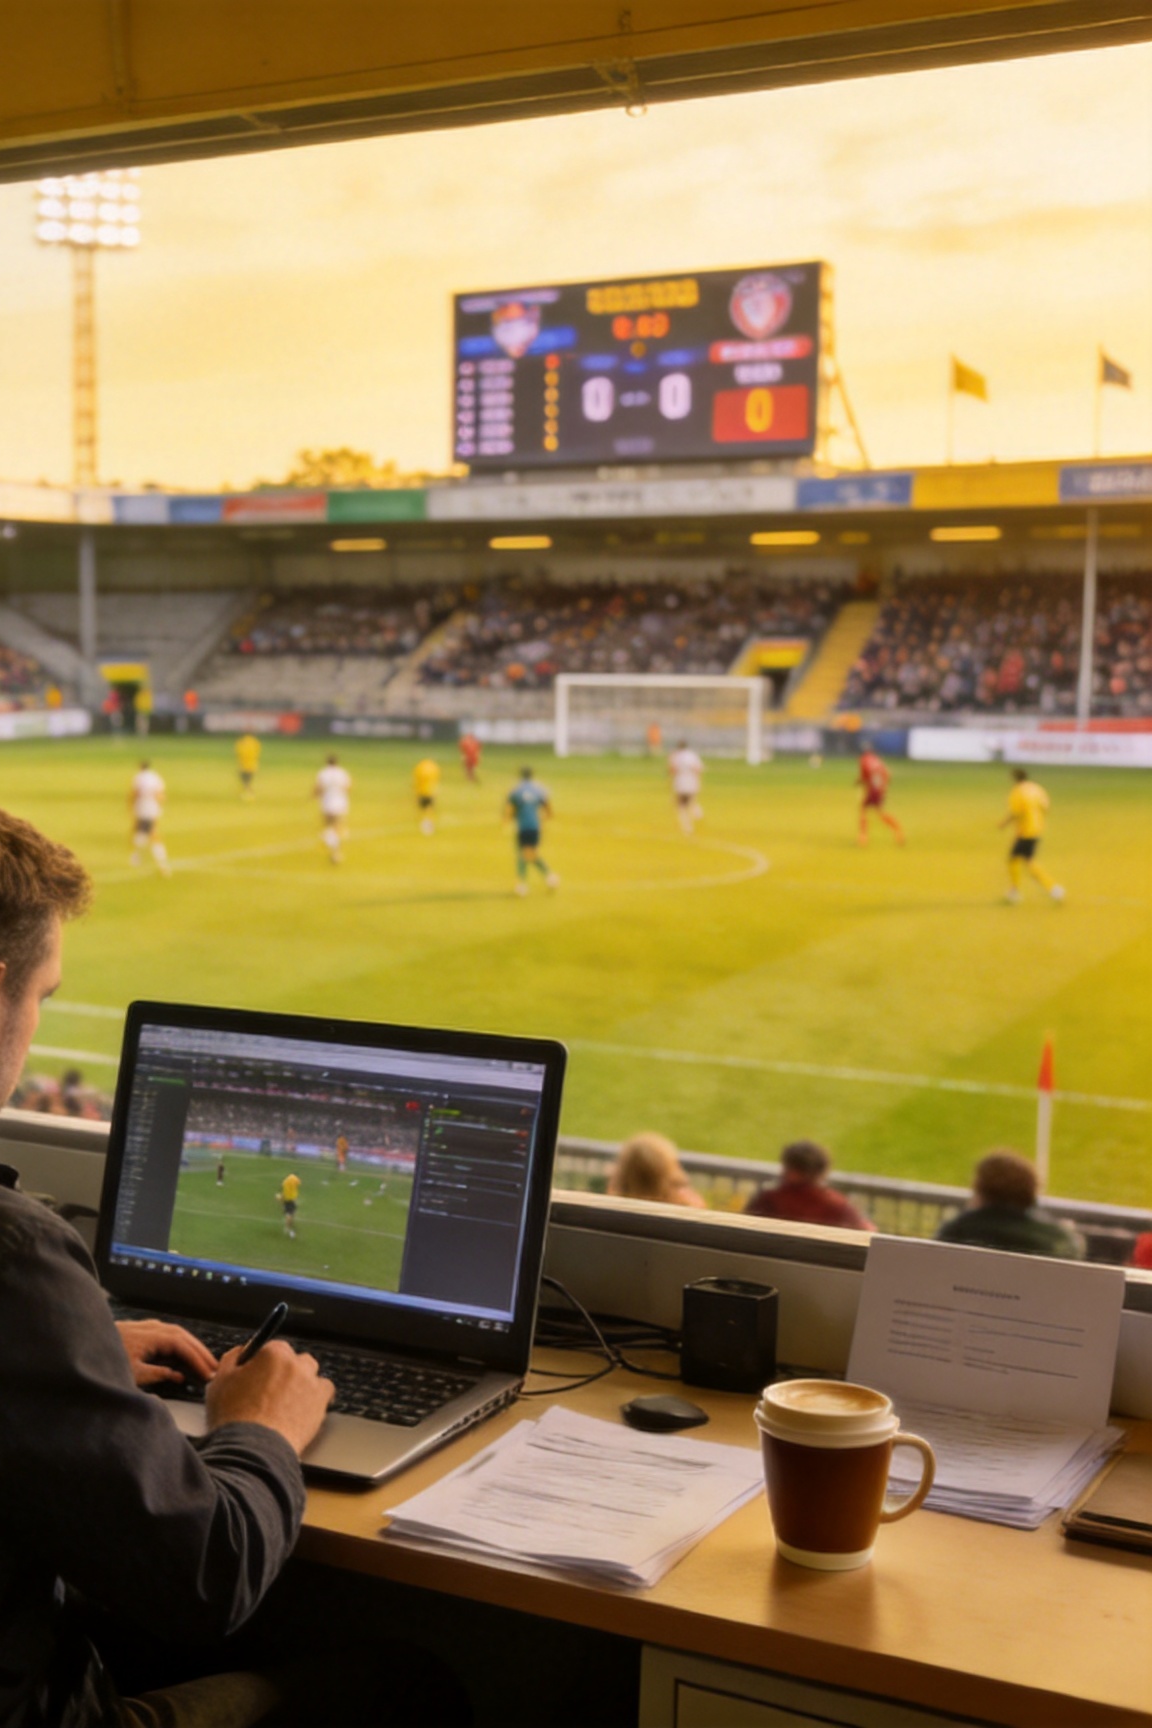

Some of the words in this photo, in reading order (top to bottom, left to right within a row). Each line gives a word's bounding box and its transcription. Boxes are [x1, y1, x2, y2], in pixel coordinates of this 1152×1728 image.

[582, 376, 615, 422] 0
[659, 371, 692, 420] 0
[745, 387, 774, 433] 0
